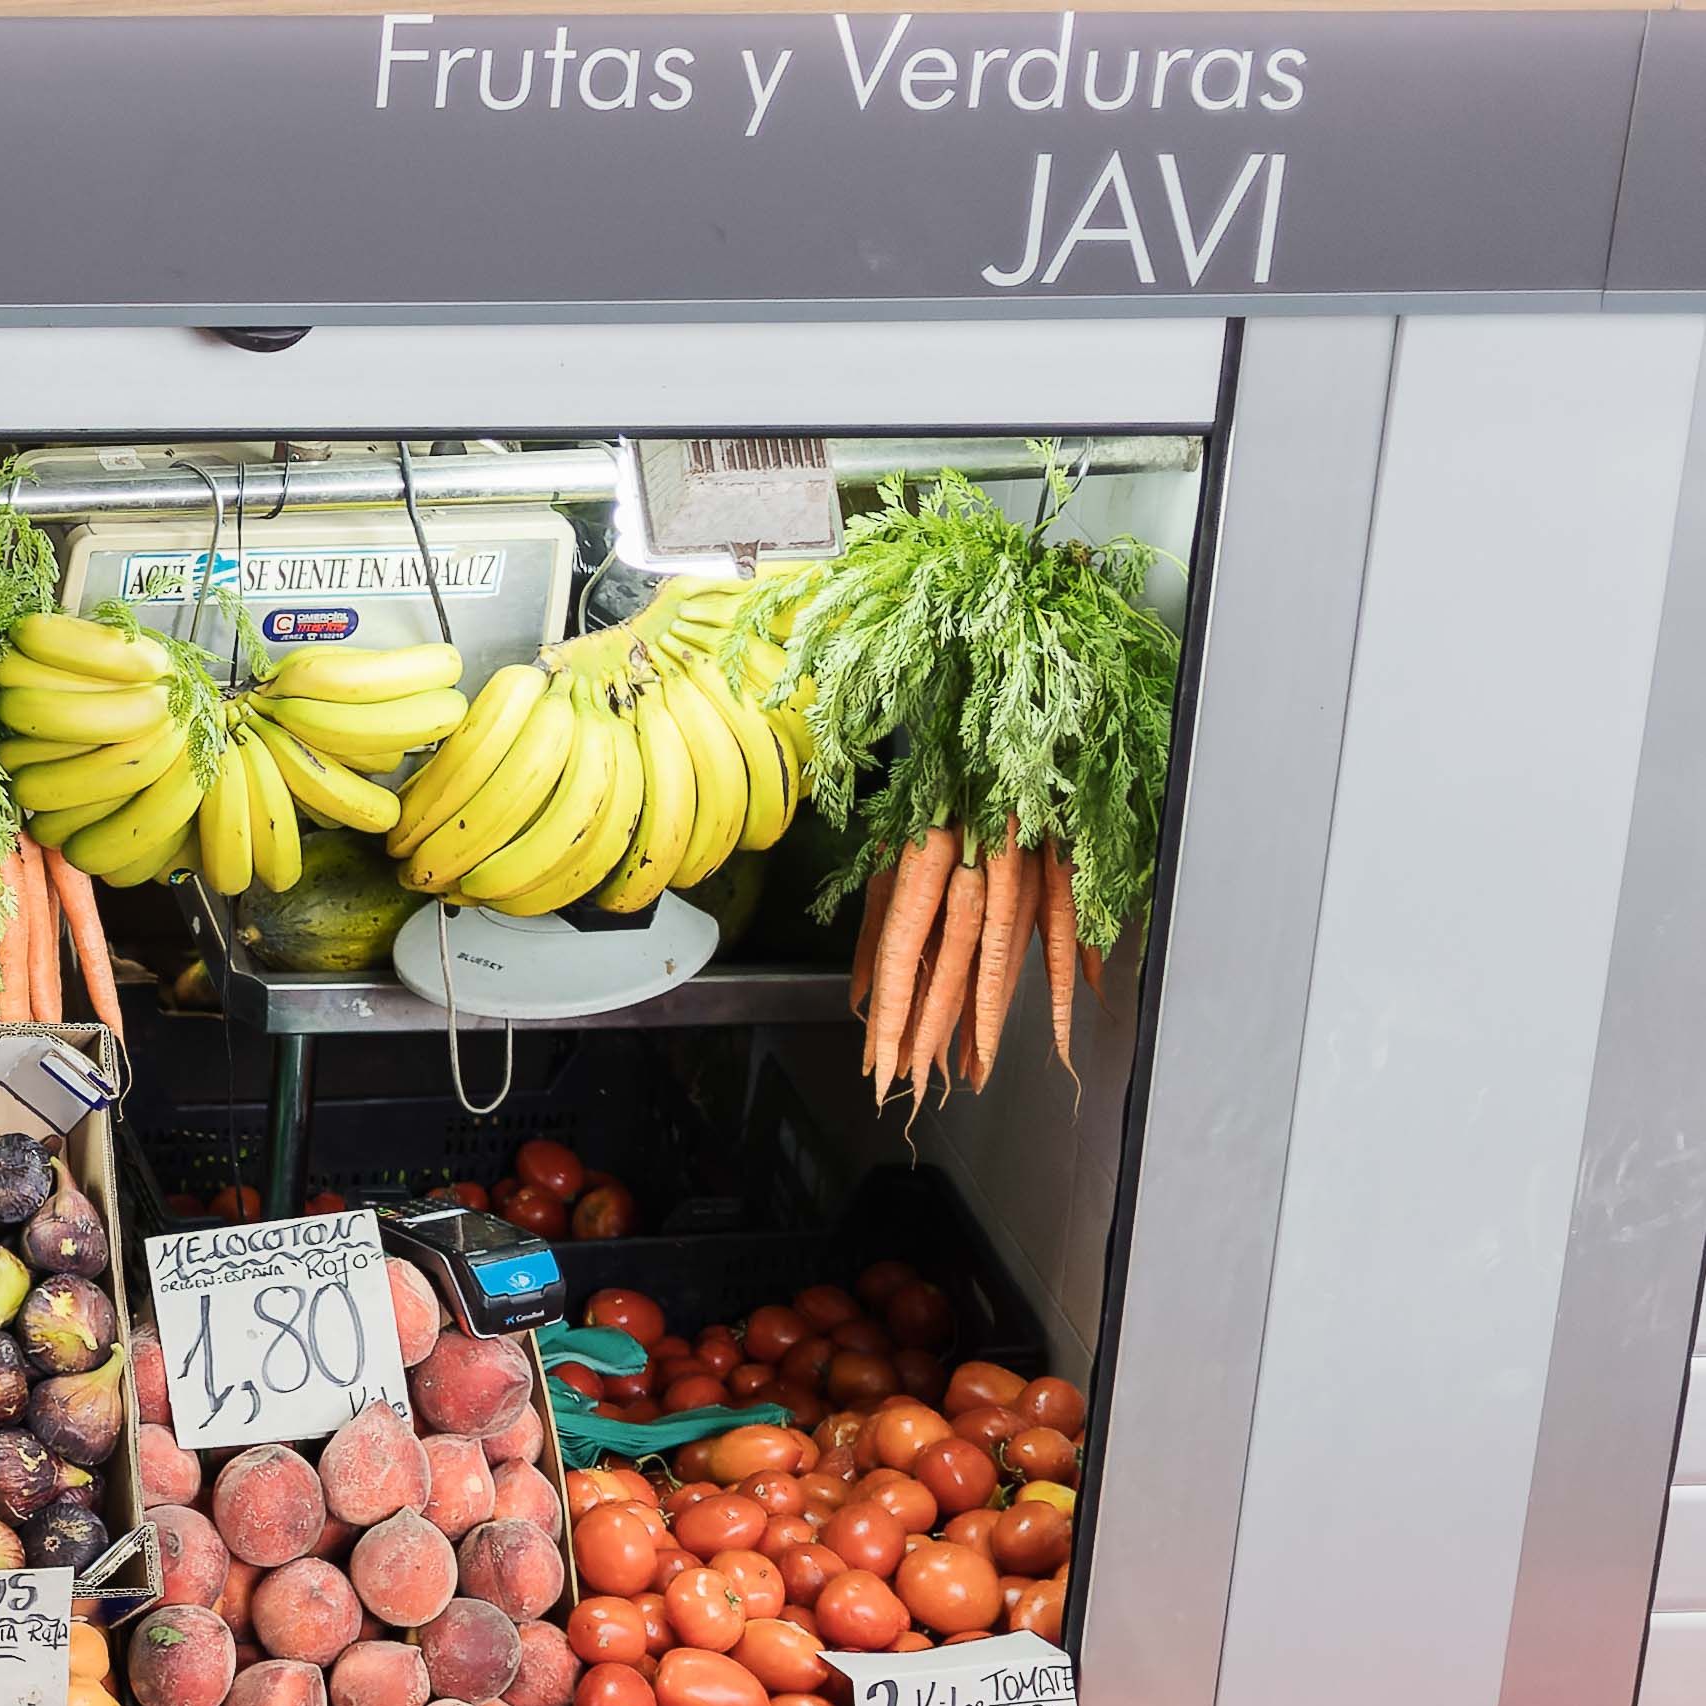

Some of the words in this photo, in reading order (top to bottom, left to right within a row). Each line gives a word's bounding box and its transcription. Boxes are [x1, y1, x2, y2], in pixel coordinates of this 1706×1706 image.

[376, 12, 694, 112] Frutas
[742, 48, 793, 137] y
[834, 10, 1308, 112] Verduras
[981, 151, 1286, 287] JAVI
[244, 559, 270, 591] SE
[276, 557, 354, 590] SIENTE
[357, 557, 392, 588] EN
[156, 1214, 367, 1281] MELOCOTON
[177, 1282, 366, 1430] 1,80
[980, 1664, 1076, 1702] TOMATE
